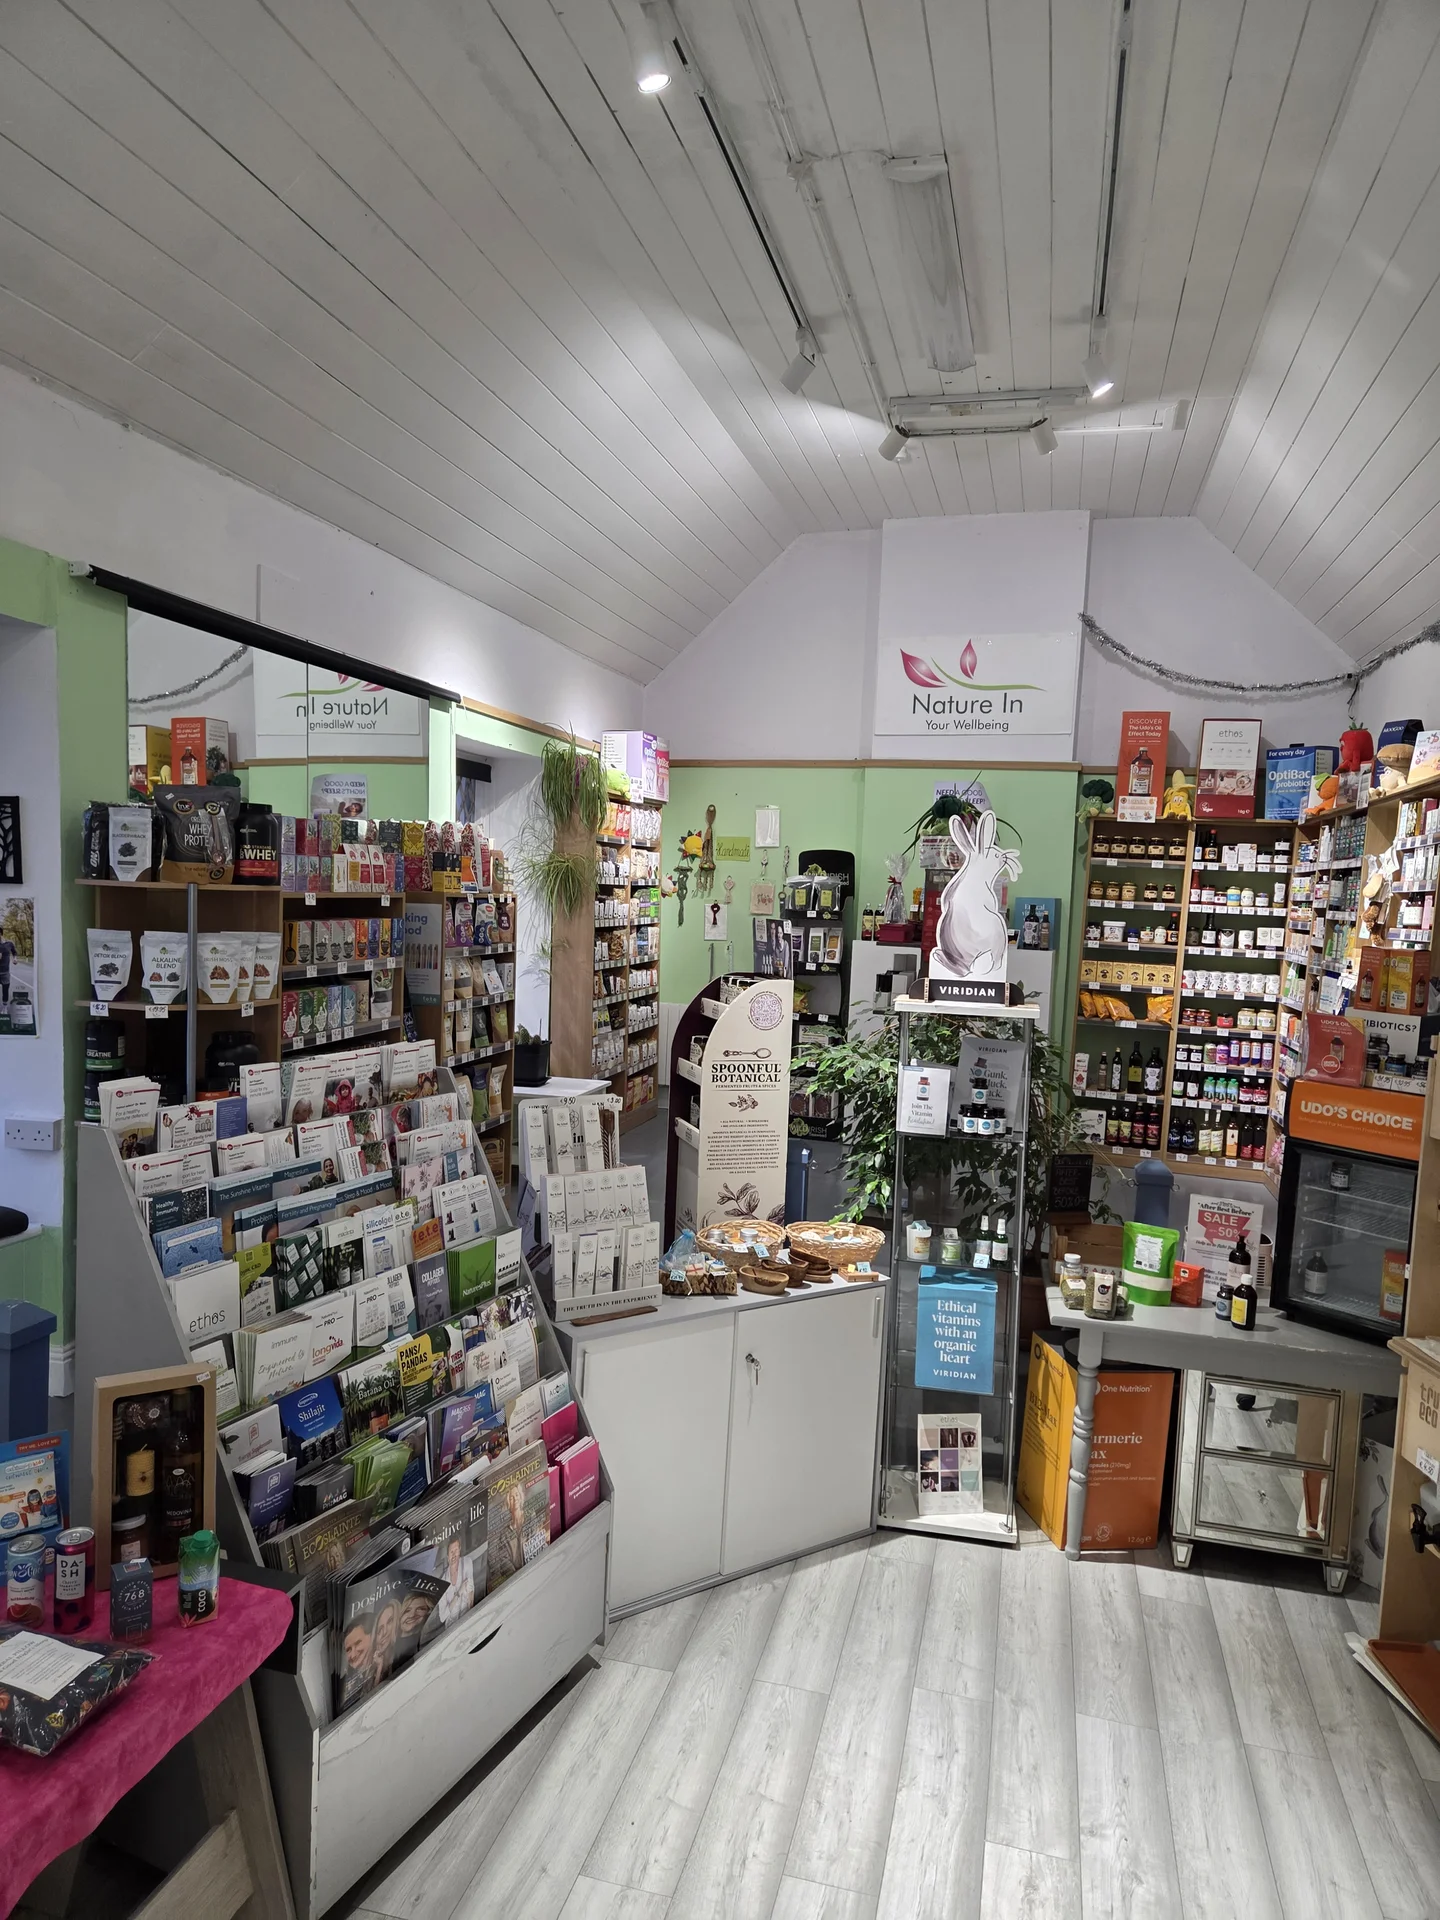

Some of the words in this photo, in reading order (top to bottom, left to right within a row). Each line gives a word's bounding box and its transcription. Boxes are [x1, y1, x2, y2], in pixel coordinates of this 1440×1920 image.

[913, 693, 993, 714] Nature
[1002, 692, 1023, 714] In
[926, 720, 950, 731] Your
[953, 719, 1010, 732] Wellbeing
[1219, 728, 1243, 740] ethos
[1268, 770, 1311, 782] OptiBac
[1276, 780, 1311, 790] probiotics
[177, 802, 190, 811] true
[189, 824, 212, 834] WHEY
[244, 850, 276, 860] WHEY
[939, 986, 995, 997] VIRIDIAN
[711, 1063, 780, 1074] SPOONFUL
[711, 1074, 780, 1083] BOTANICAL
[1300, 1100, 1348, 1119] UDO'S
[1351, 1110, 1413, 1131] CHOICE
[284, 1167, 309, 1178] Magnesium
[220, 1192, 229, 1201] The
[229, 1188, 251, 1199] Sunshine
[251, 1182, 271, 1194] Vitamin
[155, 1199, 174, 1210] Healthy
[155, 1205, 179, 1217] Immunity
[281, 1209, 298, 1219] Fertility
[299, 1207, 308, 1215] and
[309, 1202, 332, 1214] Pregnancy
[251, 1212, 272, 1226] Problem
[366, 1214, 393, 1230] silicolgel
[1204, 1212, 1238, 1227] SALE
[1218, 1227, 1240, 1239] 50%
[422, 1266, 444, 1284] COLLAGEN
[462, 1279, 492, 1296] NaturesPlus
[366, 1294, 376, 1303] PRO
[576, 1304, 596, 1312] TRUTH
[622, 1294, 657, 1305] EXPERIENCE
[937, 1300, 976, 1314] Ethical
[189, 1310, 226, 1333] ethos
[324, 1318, 335, 1327] PRO
[932, 1313, 980, 1327] vitamins
[935, 1326, 961, 1339] with
[962, 1330, 976, 1340] an
[271, 1335, 298, 1349] immune
[934, 1340, 976, 1354] organic
[400, 1343, 420, 1362] PANS/
[451, 1350, 463, 1362] TIRED
[939, 1353, 970, 1365] heart
[401, 1352, 428, 1372] PANDAS
[933, 1369, 976, 1380] VIRIDIAN
[358, 1385, 382, 1400] Batana
[384, 1379, 395, 1390] Oil
[1102, 1385, 1118, 1393] One
[298, 1404, 326, 1422] Shilajit
[1419, 1402, 1438, 1428] eco
[1091, 1452, 1107, 1460] ax
[470, 1502, 484, 1522] life
[1128, 1536, 1144, 1544] 12.6g
[125, 1589, 145, 1602] 768
[351, 1580, 401, 1618] positive
[414, 1578, 440, 1593] life
